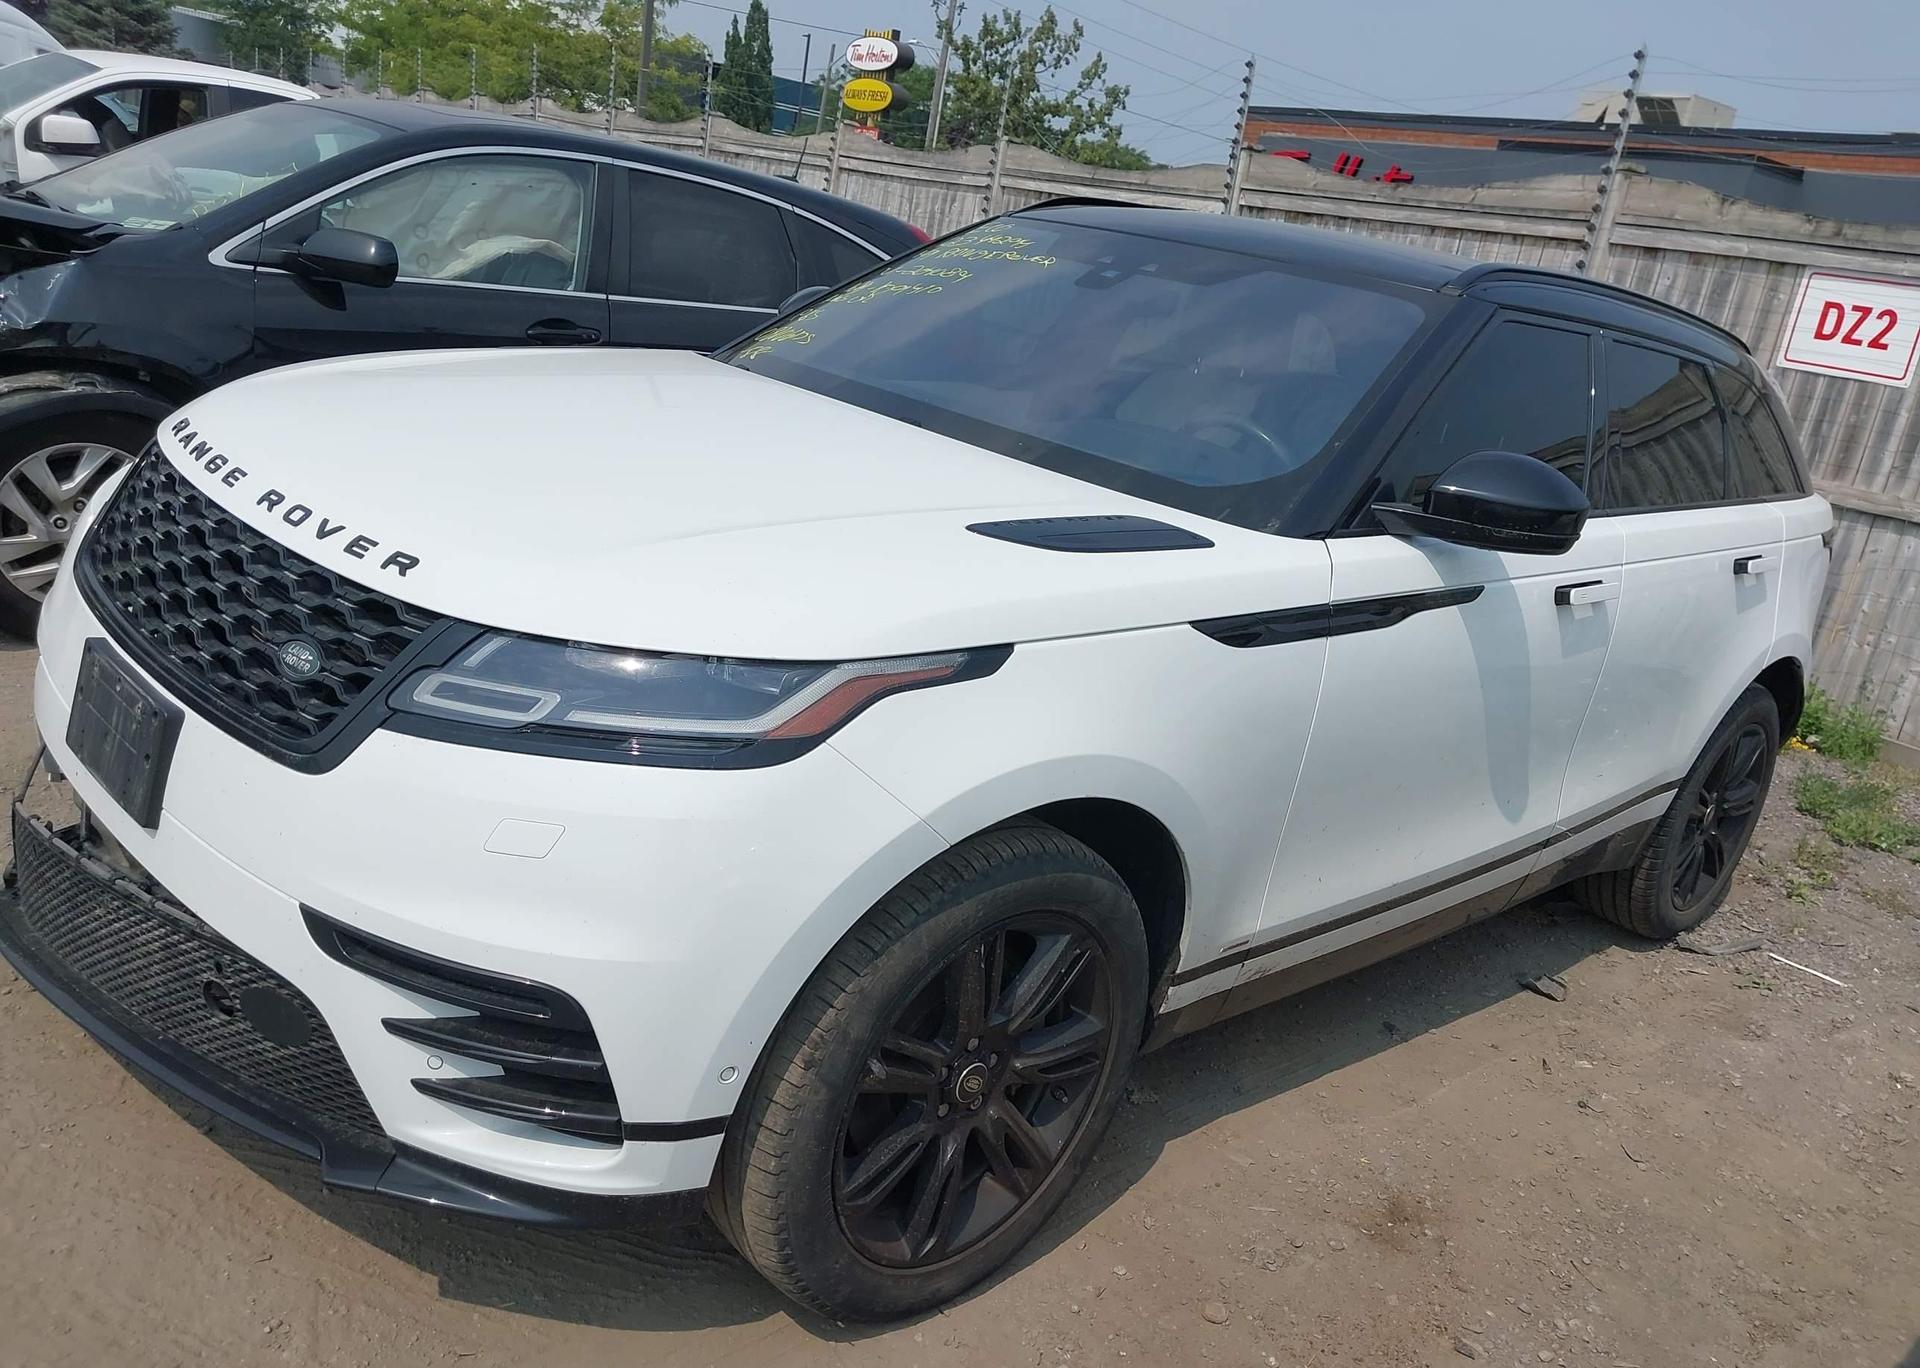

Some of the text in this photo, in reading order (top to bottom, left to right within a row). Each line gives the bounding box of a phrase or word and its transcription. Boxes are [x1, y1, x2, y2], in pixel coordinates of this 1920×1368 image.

[851, 43, 894, 63] Tim Hortons
[845, 88, 888, 102] ALWAYS FRESH
[1813, 300, 1898, 351] DZ2
[171, 417, 420, 578] RANGE ROVER
[288, 643, 311, 660] LAND
[284, 653, 311, 673] ROVER
